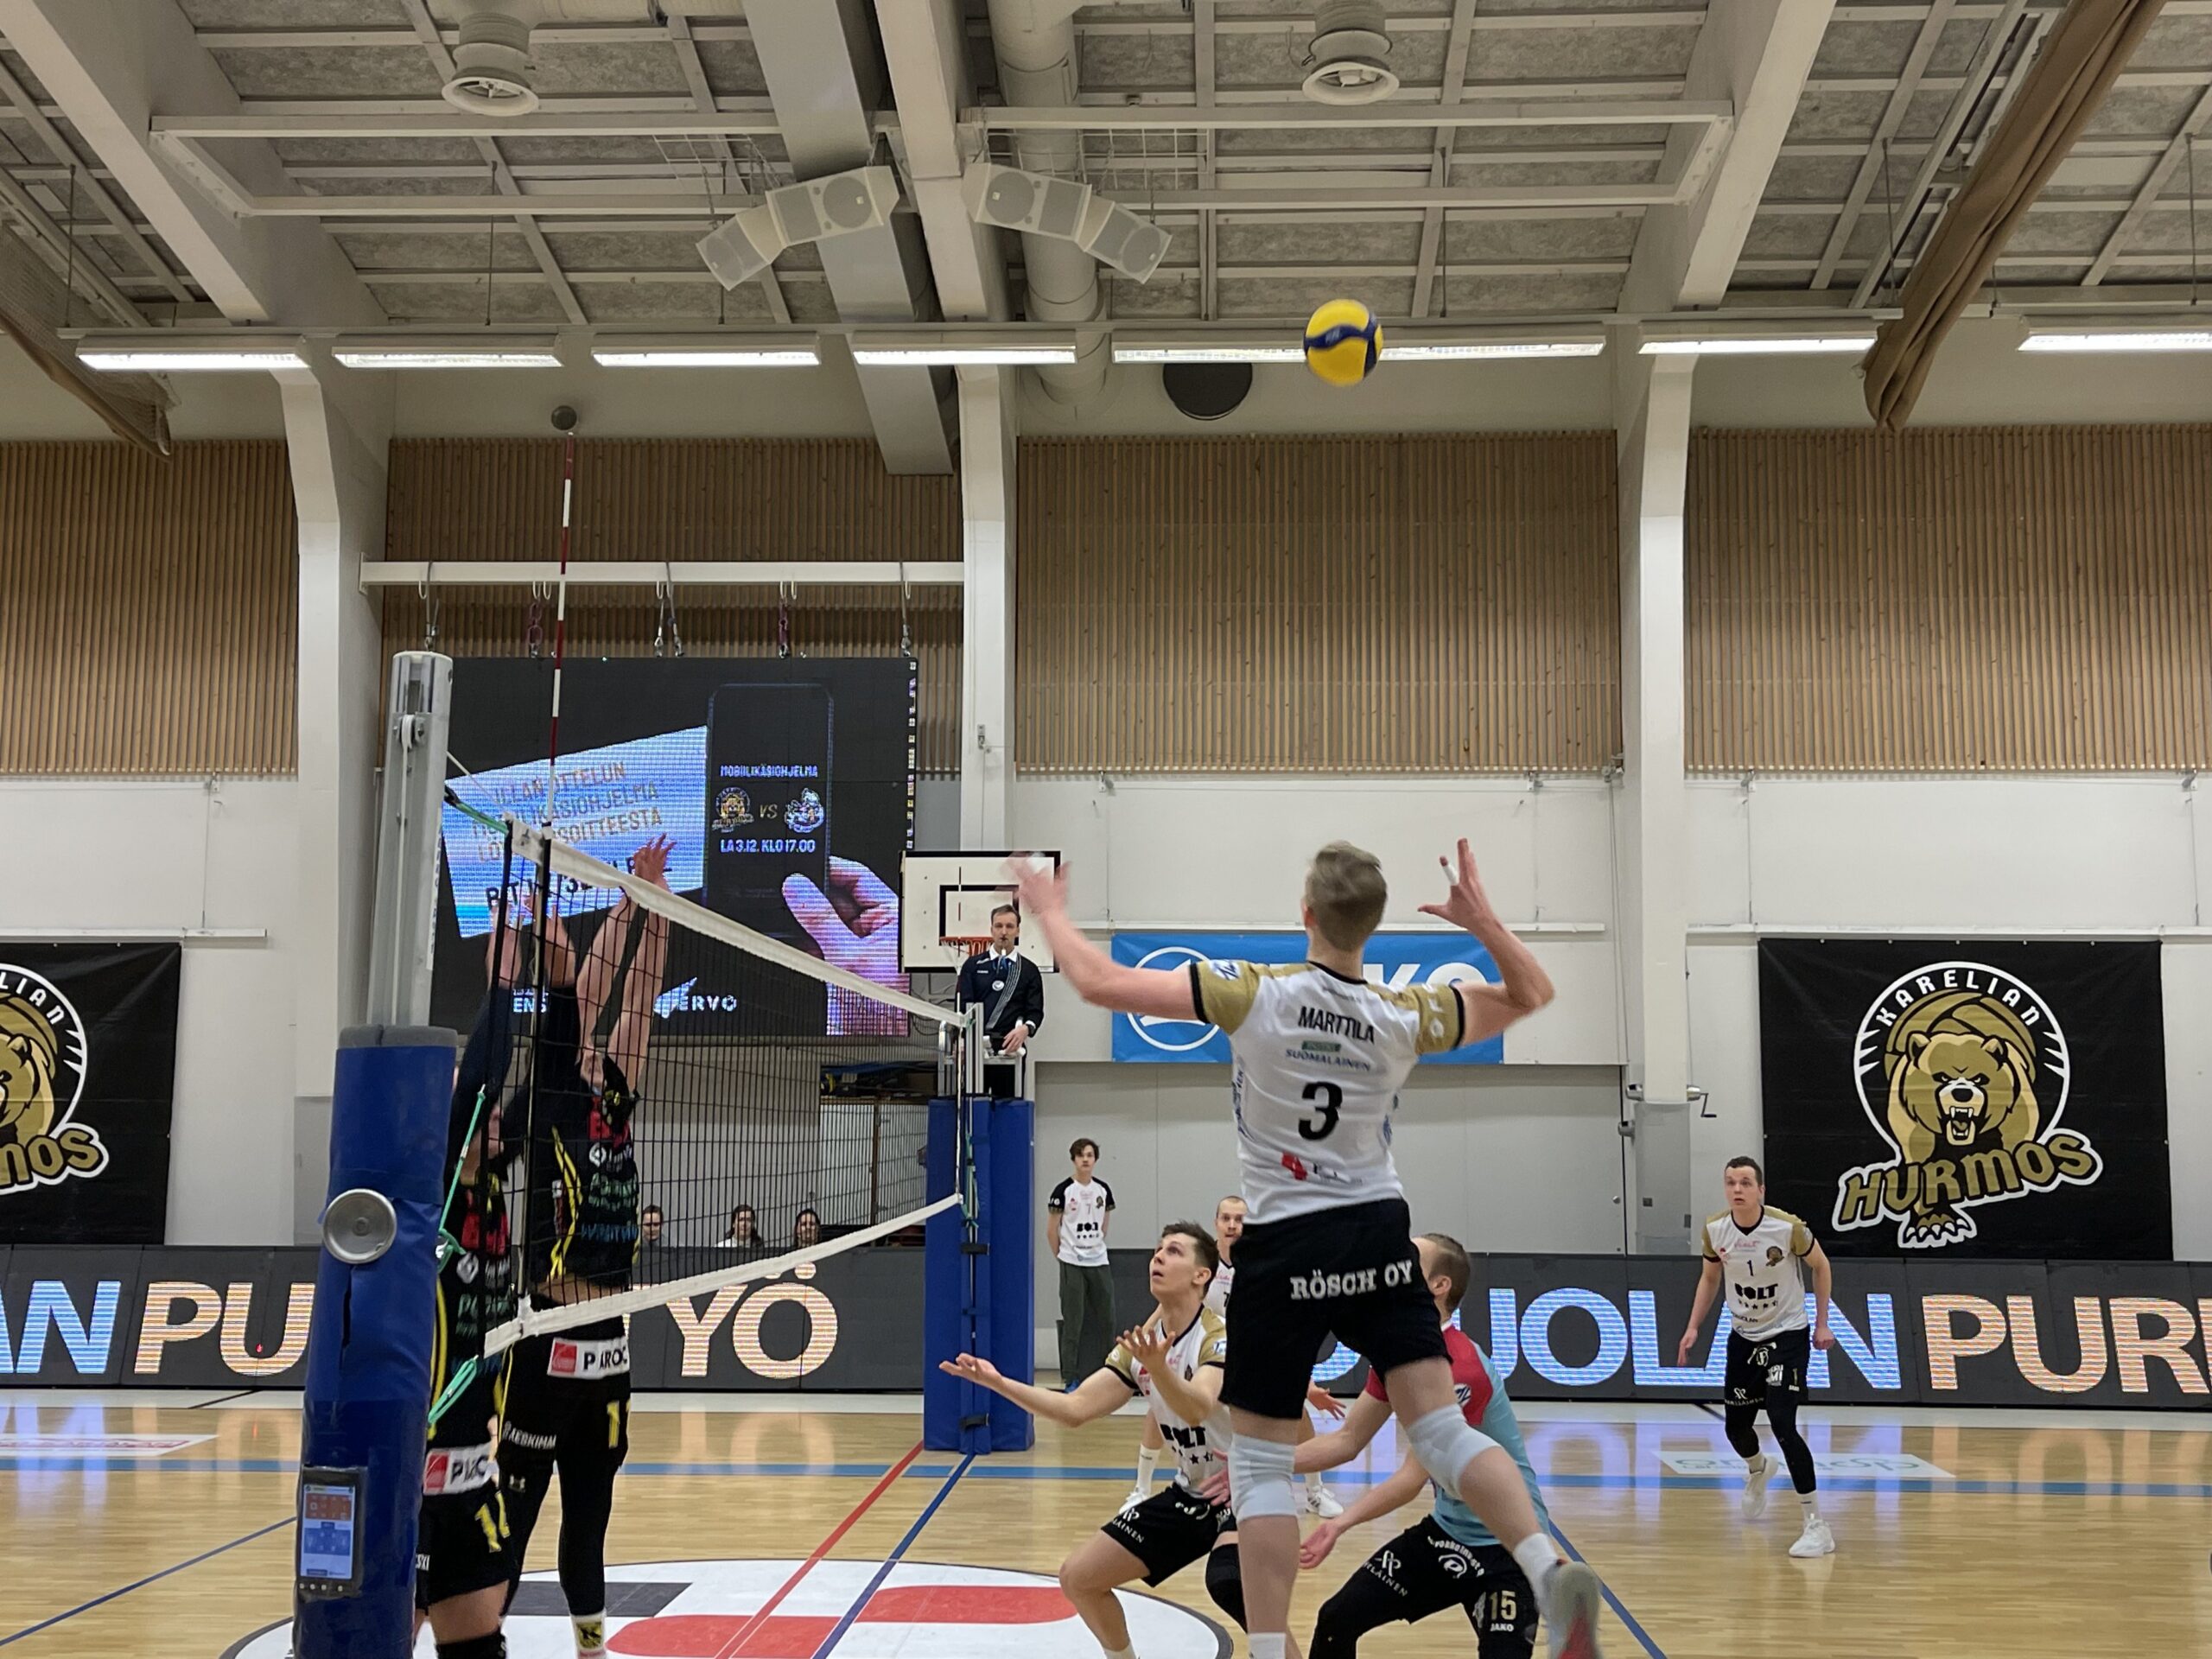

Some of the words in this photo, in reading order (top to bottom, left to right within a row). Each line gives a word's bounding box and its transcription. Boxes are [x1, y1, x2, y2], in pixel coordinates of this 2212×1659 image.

[1876, 969, 2042, 1027] KARELIAN
[1298, 1005, 1375, 1045] MARTTILA
[1298, 1081, 1344, 1141] 3
[1837, 1136, 2097, 1221] HURMOS
[1289, 1268, 1377, 1300] RÖSCH
[1384, 1259, 1414, 1287] OY
[1489, 1590, 1517, 1621] 15
